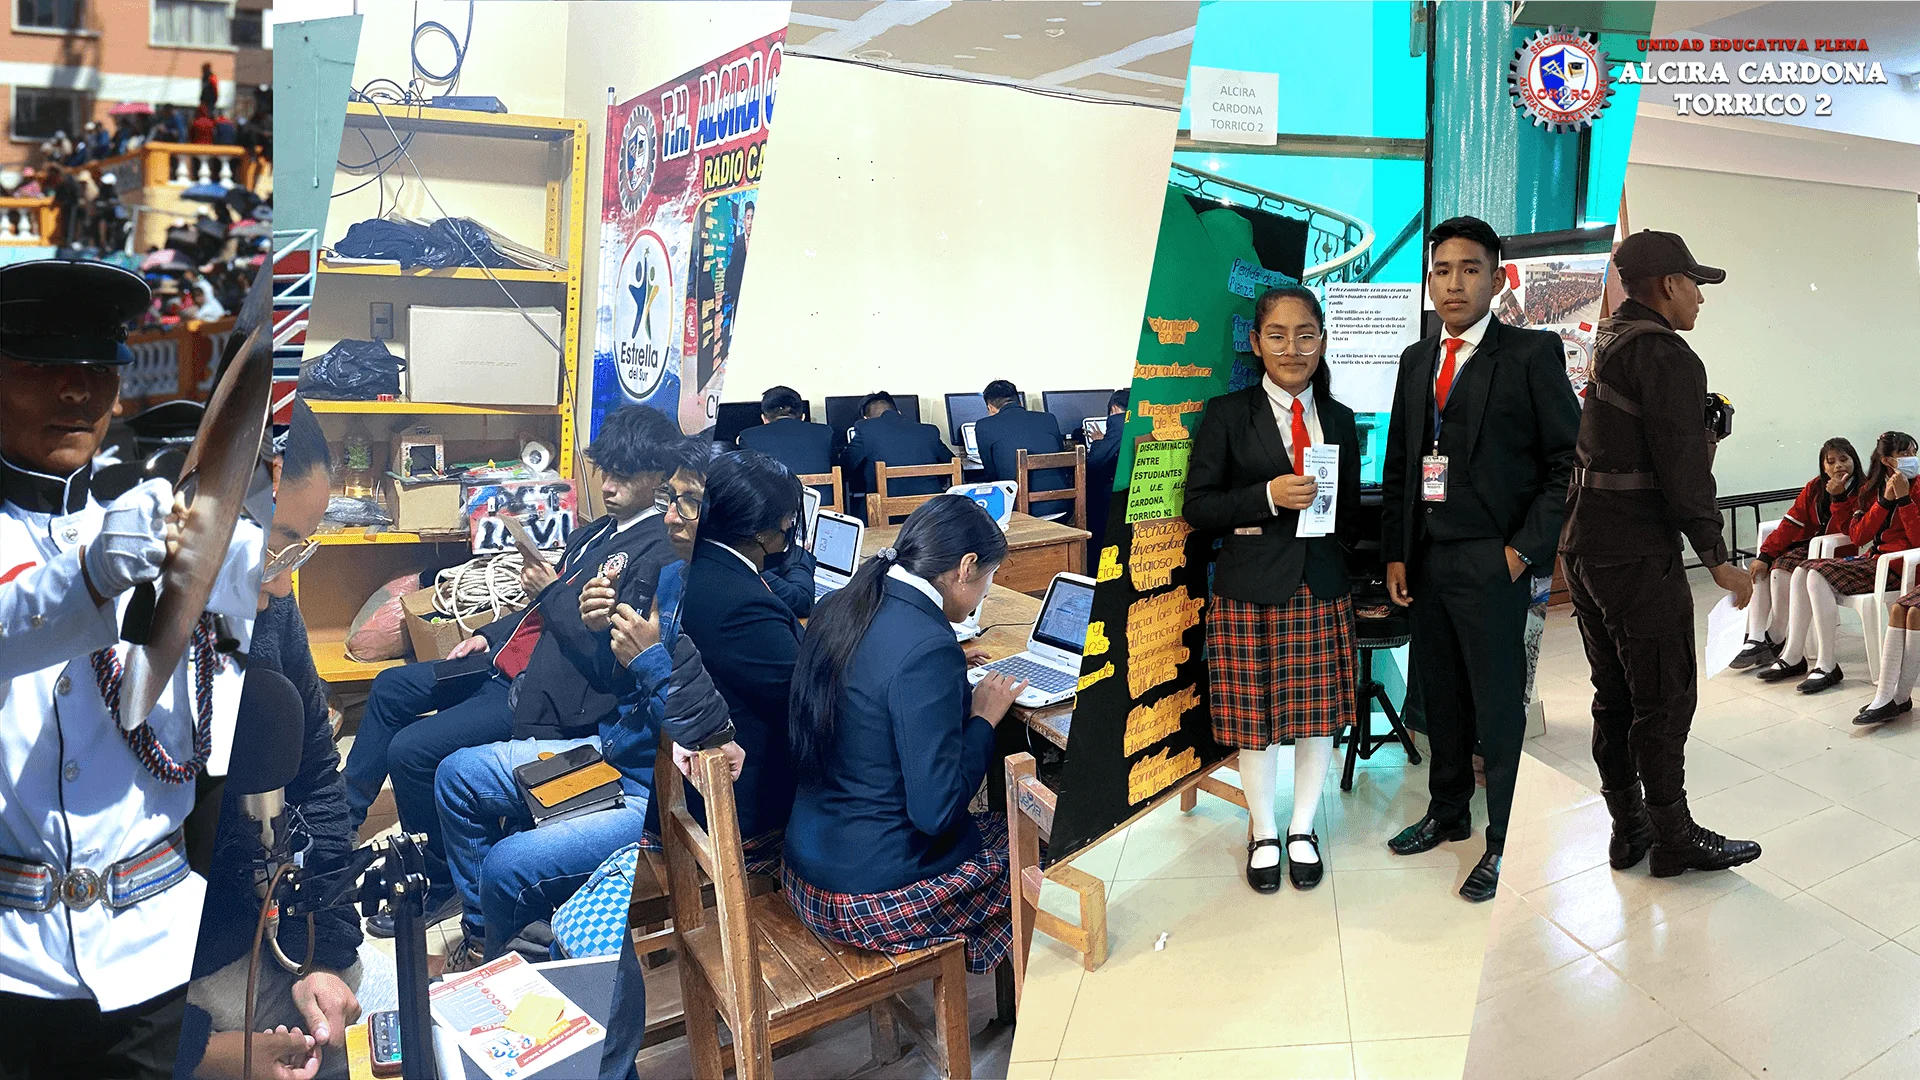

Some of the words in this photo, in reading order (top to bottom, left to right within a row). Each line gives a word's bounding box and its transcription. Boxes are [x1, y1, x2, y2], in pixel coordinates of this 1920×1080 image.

[1220, 85, 1256, 98] ALCIRA
[695, 51, 763, 150] ALCIRA
[1212, 101, 1263, 115] CARDONA
[1211, 118, 1255, 132] TORRICO
[1257, 122, 1264, 132] 2
[703, 147, 744, 192] RADIO
[620, 342, 658, 369] Estrella
[628, 366, 638, 380] del
[638, 370, 649, 382] Sur
[1136, 457, 1160, 466] ENTRE
[1134, 469, 1182, 480] ESTUDIANTES
[1132, 486, 1140, 494] LA
[1130, 496, 1164, 508] CARDONA
[1129, 510, 1161, 521] TORRICO
[1133, 522, 1180, 538] Rechazo
